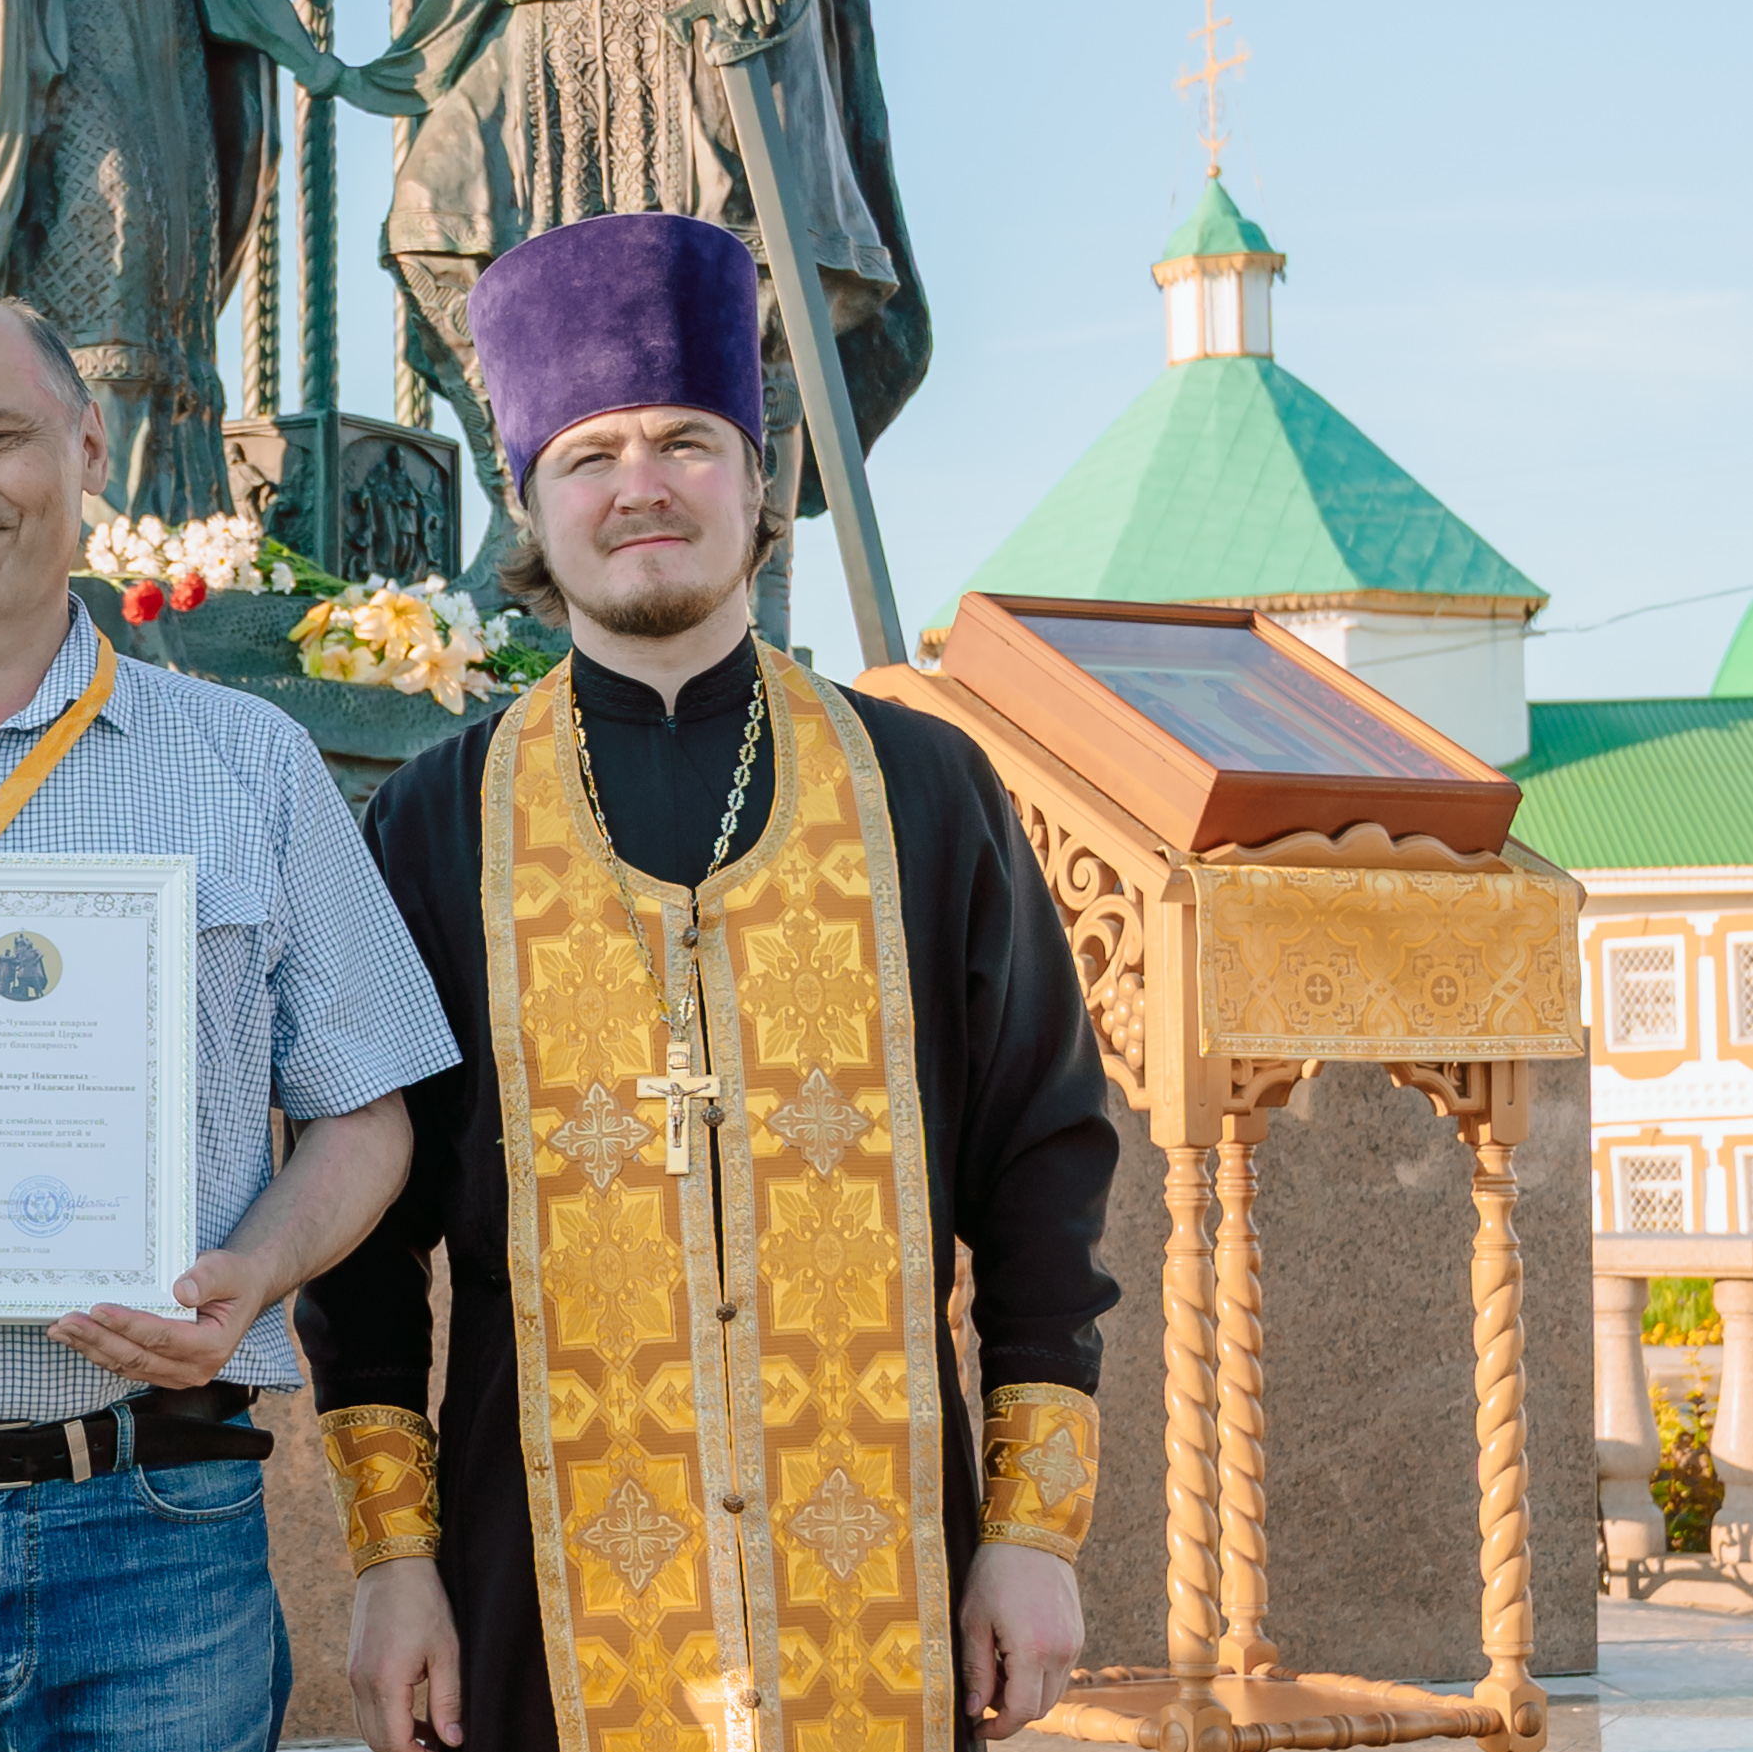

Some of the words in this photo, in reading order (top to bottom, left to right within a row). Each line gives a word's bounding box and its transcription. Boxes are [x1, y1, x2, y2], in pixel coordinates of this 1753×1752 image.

[60, 1020, 98, 1029] епархия
[58, 1030, 93, 1040] Церкви
[10, 1041, 78, 1051] благодарность
[6, 1073, 29, 1081] паре
[32, 1071, 89, 1080] Никитиных
[33, 1083, 75, 1092] Надежде
[77, 1083, 136, 1092] Николаевне
[5, 1117, 52, 1125] семейных
[55, 1118, 108, 1127] ценностей,
[55, 1129, 83, 1137] детей
